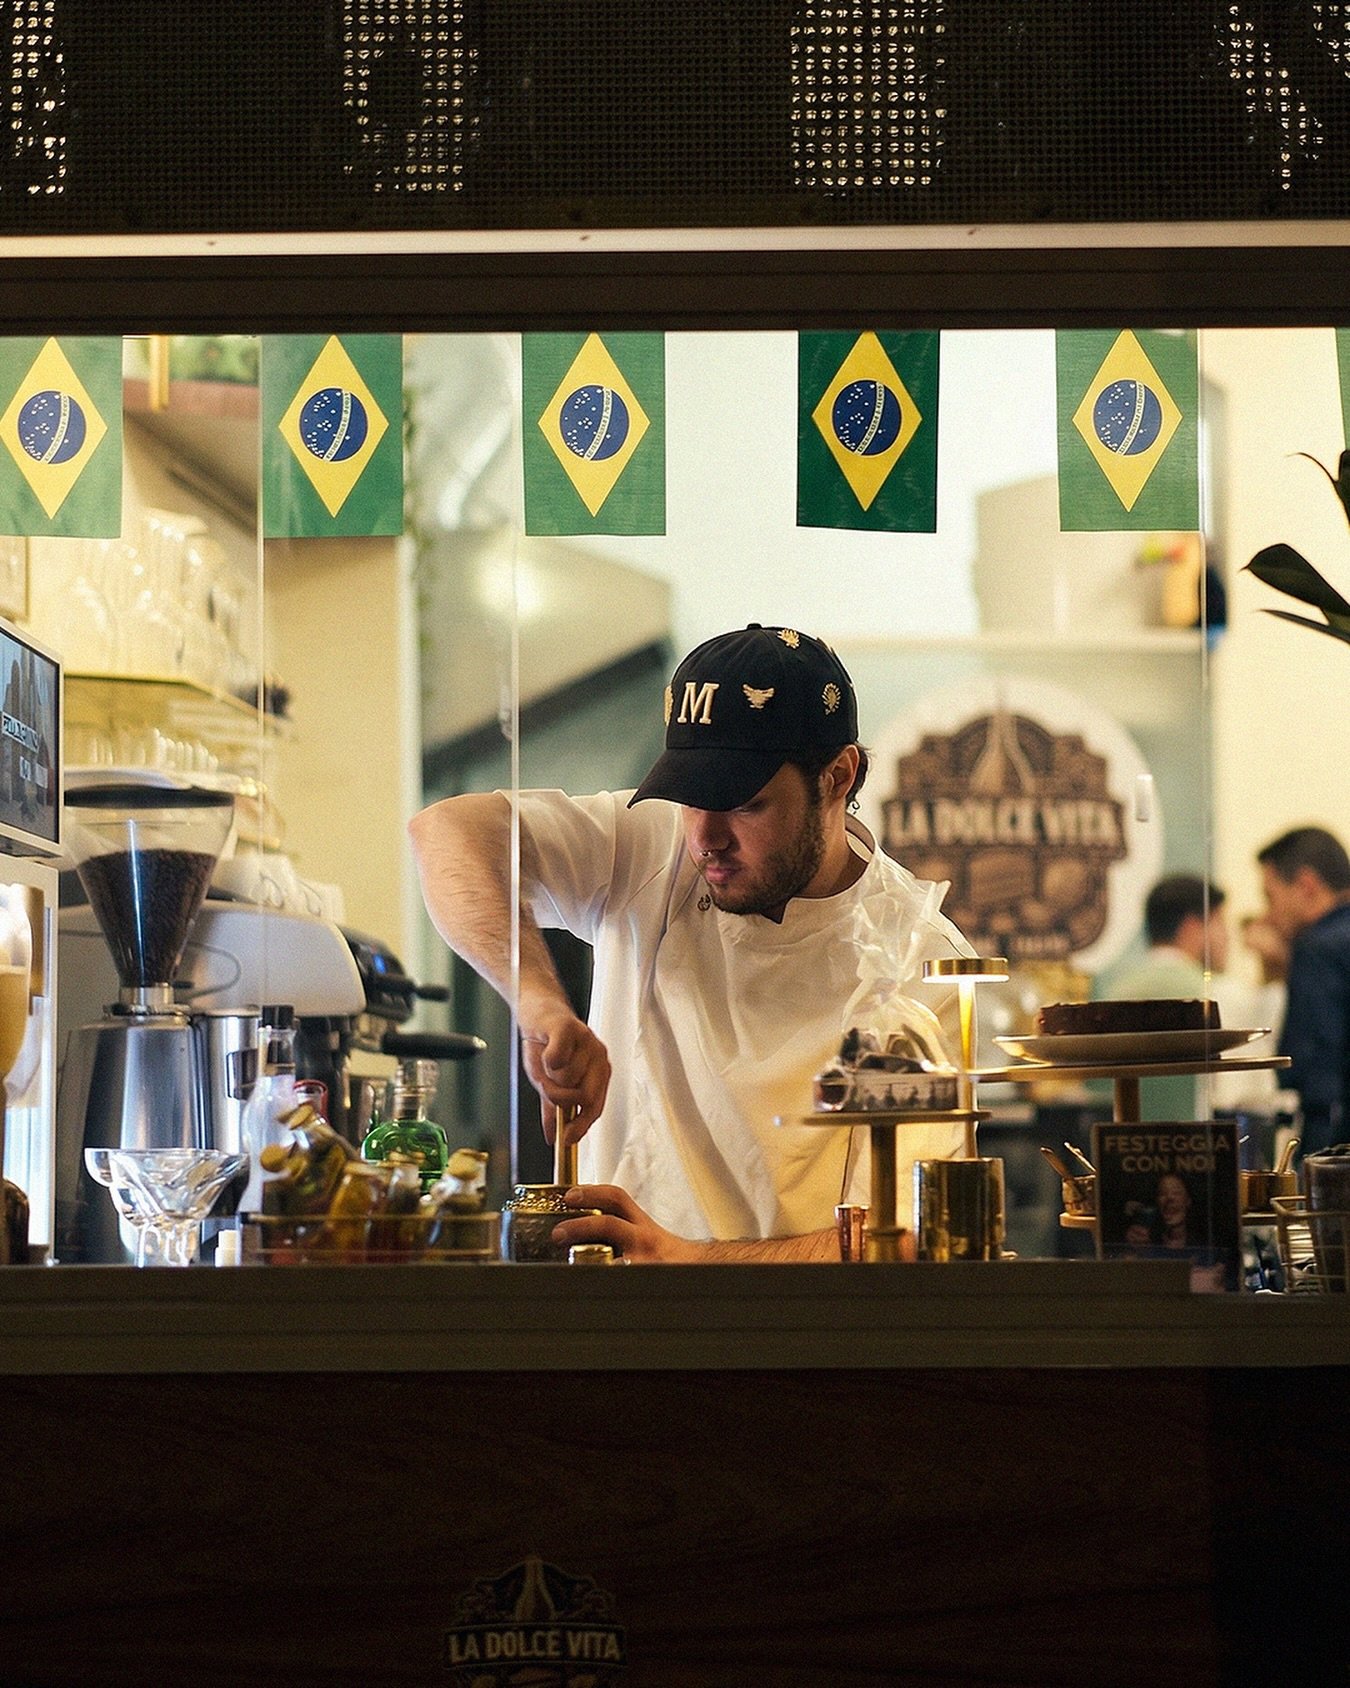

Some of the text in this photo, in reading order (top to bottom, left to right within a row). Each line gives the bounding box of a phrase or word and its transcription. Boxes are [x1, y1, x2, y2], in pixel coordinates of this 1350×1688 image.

[677, 681, 720, 725] M
[1121, 1155, 1169, 1173] CON
[448, 1630, 621, 1663] LA DOLCE VITA
